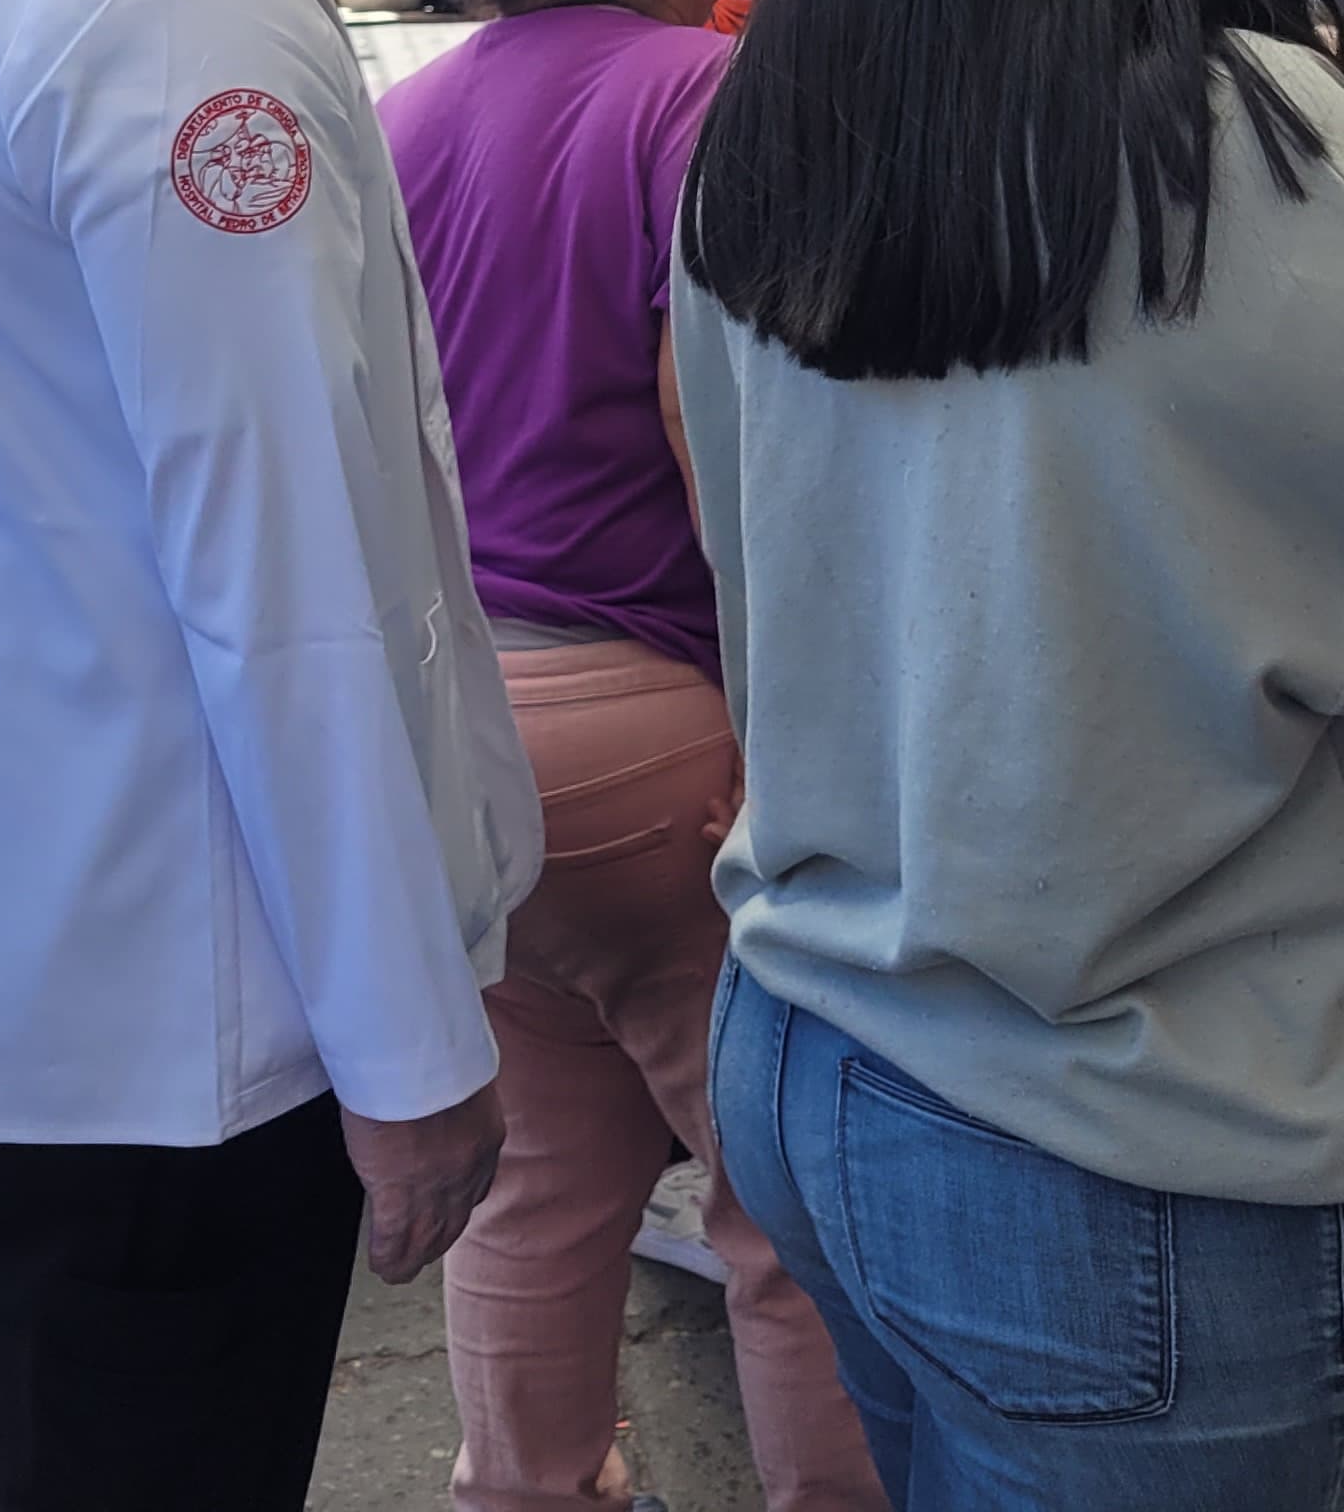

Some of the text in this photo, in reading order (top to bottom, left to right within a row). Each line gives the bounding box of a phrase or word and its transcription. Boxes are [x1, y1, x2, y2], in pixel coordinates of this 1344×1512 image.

[176, 94, 242, 161] DEPARTAMENTO
[247, 95, 262, 106] DE
[177, 174, 213, 221] HOSPITAL
[218, 216, 258, 231] PEDRO
[261, 211, 277, 226] DE
